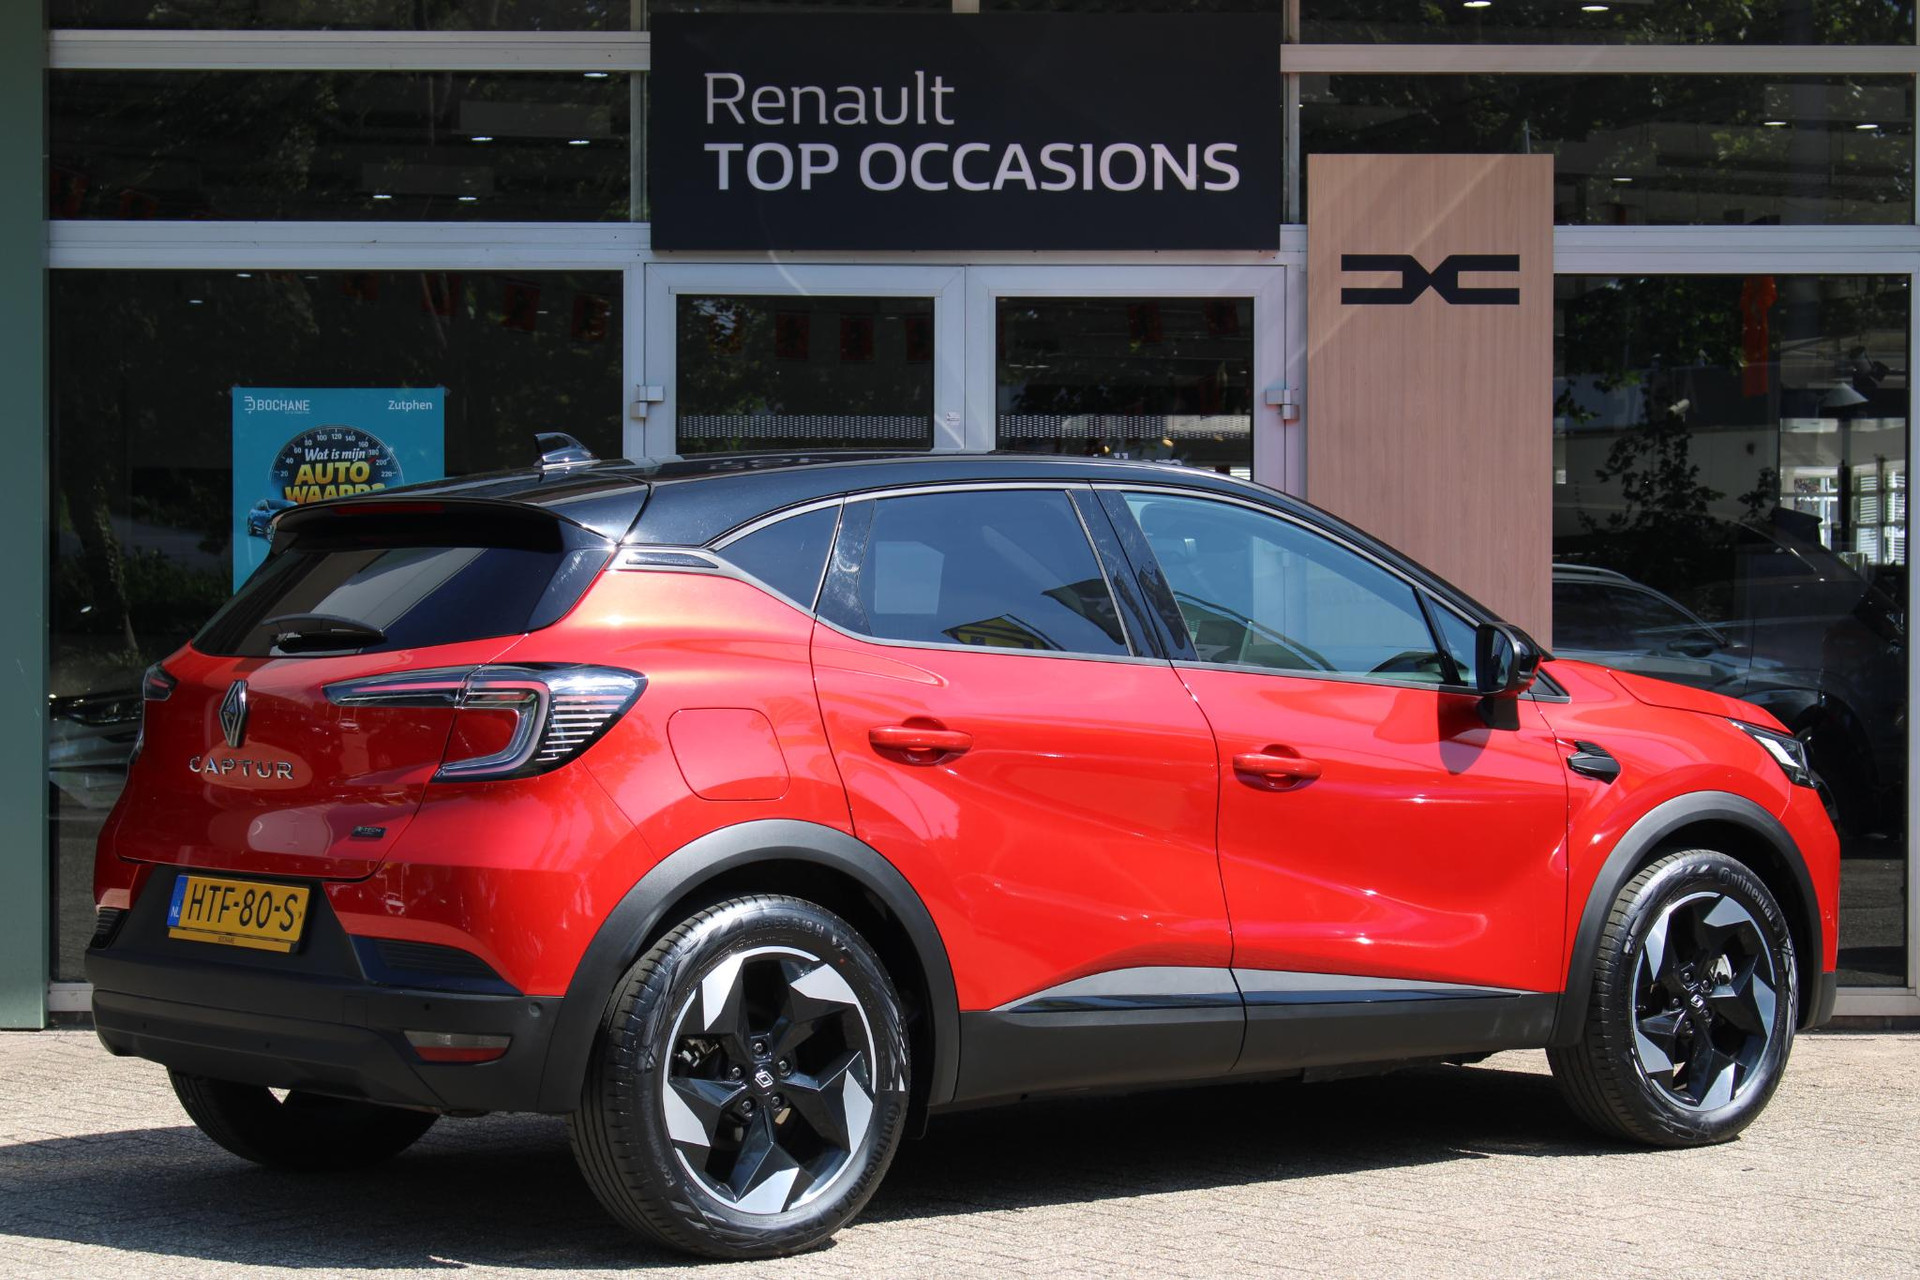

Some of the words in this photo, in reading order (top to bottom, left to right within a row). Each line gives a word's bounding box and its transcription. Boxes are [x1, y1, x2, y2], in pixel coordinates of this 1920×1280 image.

[704, 70, 955, 126] Renault
[704, 143, 839, 190] TOP
[860, 143, 1240, 191] OCCASIONS
[257, 399, 310, 411] BOCHANE
[388, 400, 433, 412] Zutphen
[304, 447, 329, 461] Wat
[331, 448, 339, 460] is
[342, 447, 366, 461] mijn
[294, 461, 370, 485] AUTO
[189, 756, 294, 780] CAPTUR
[1719, 867, 1777, 921] Continental
[170, 906, 179, 918] NL
[188, 884, 298, 932] HTF-80-S
